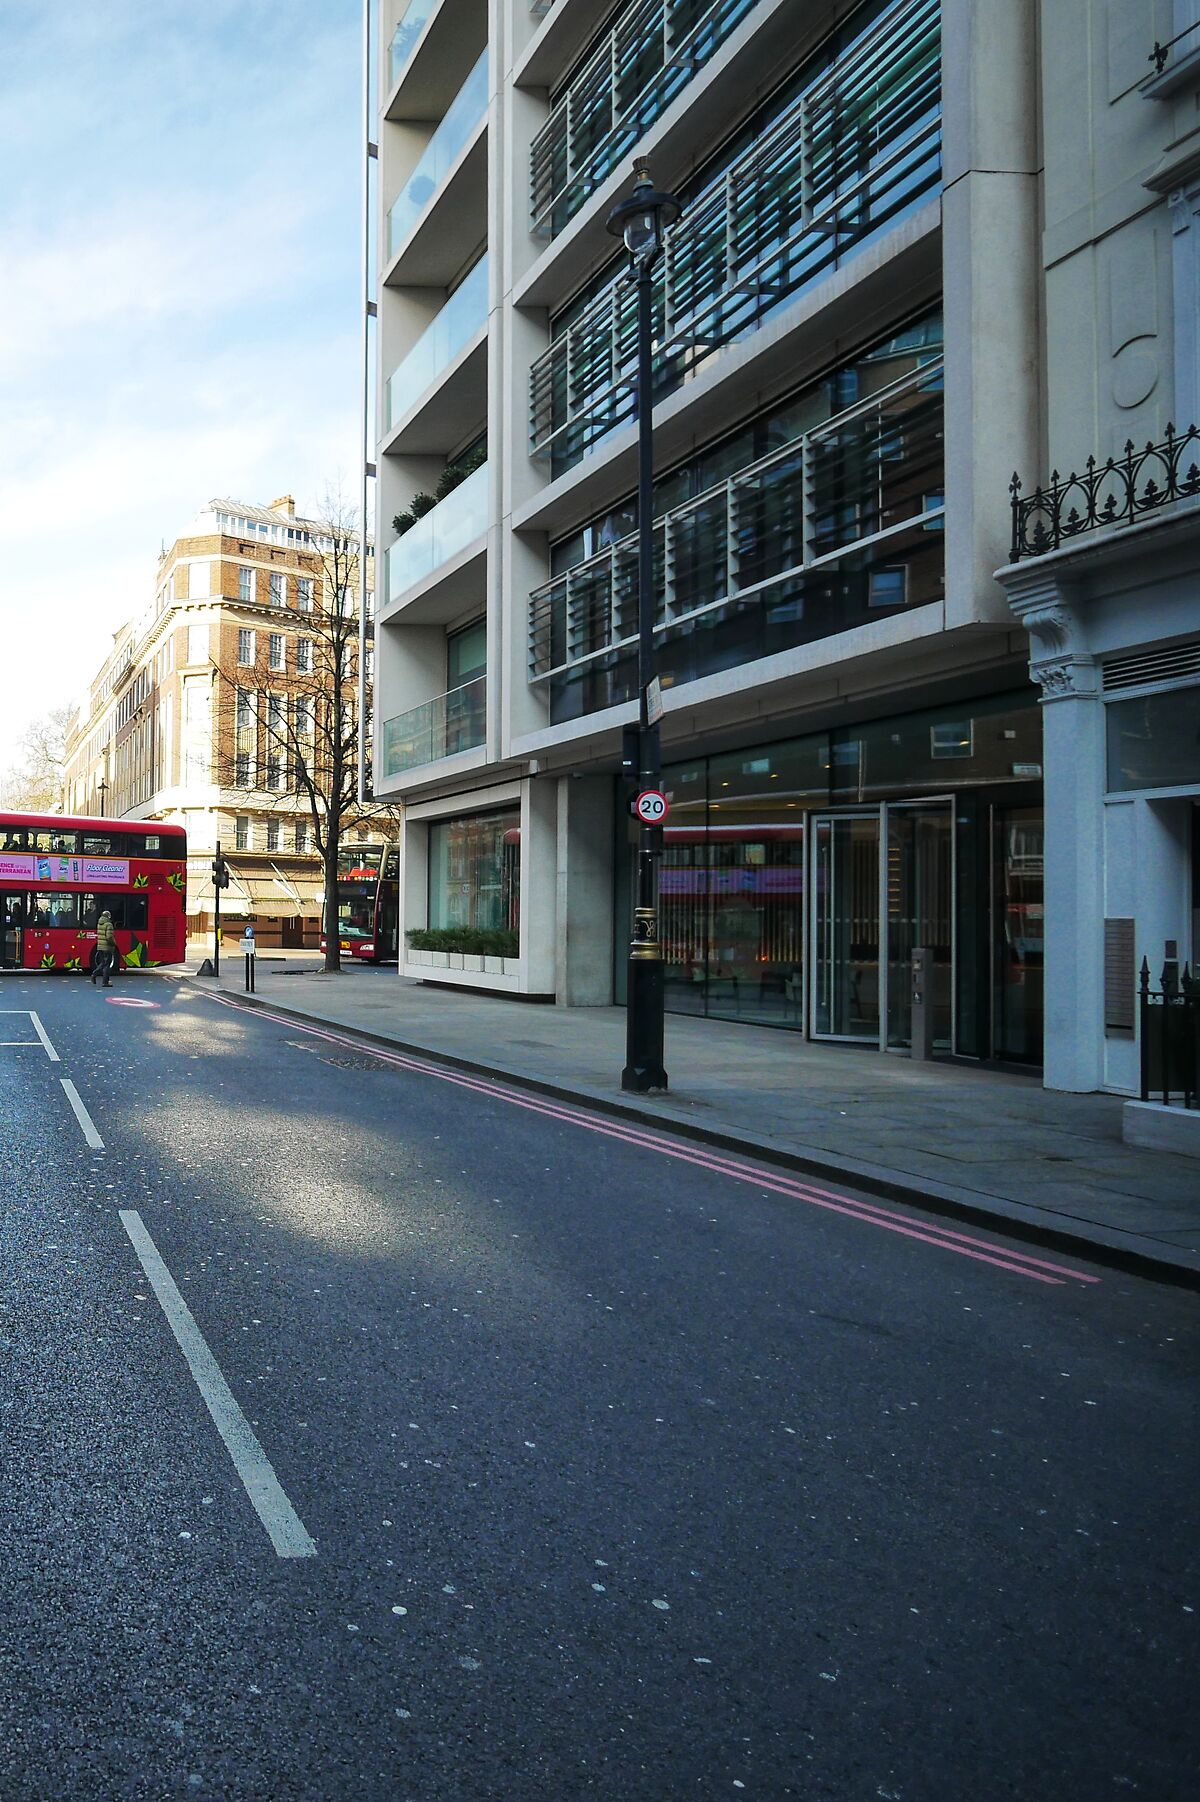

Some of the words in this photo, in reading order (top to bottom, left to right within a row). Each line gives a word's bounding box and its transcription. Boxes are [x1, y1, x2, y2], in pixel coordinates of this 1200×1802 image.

[641, 801, 664, 813] 20
[86, 863, 102, 872] Floor
[102, 864, 125, 873] Cleaner
